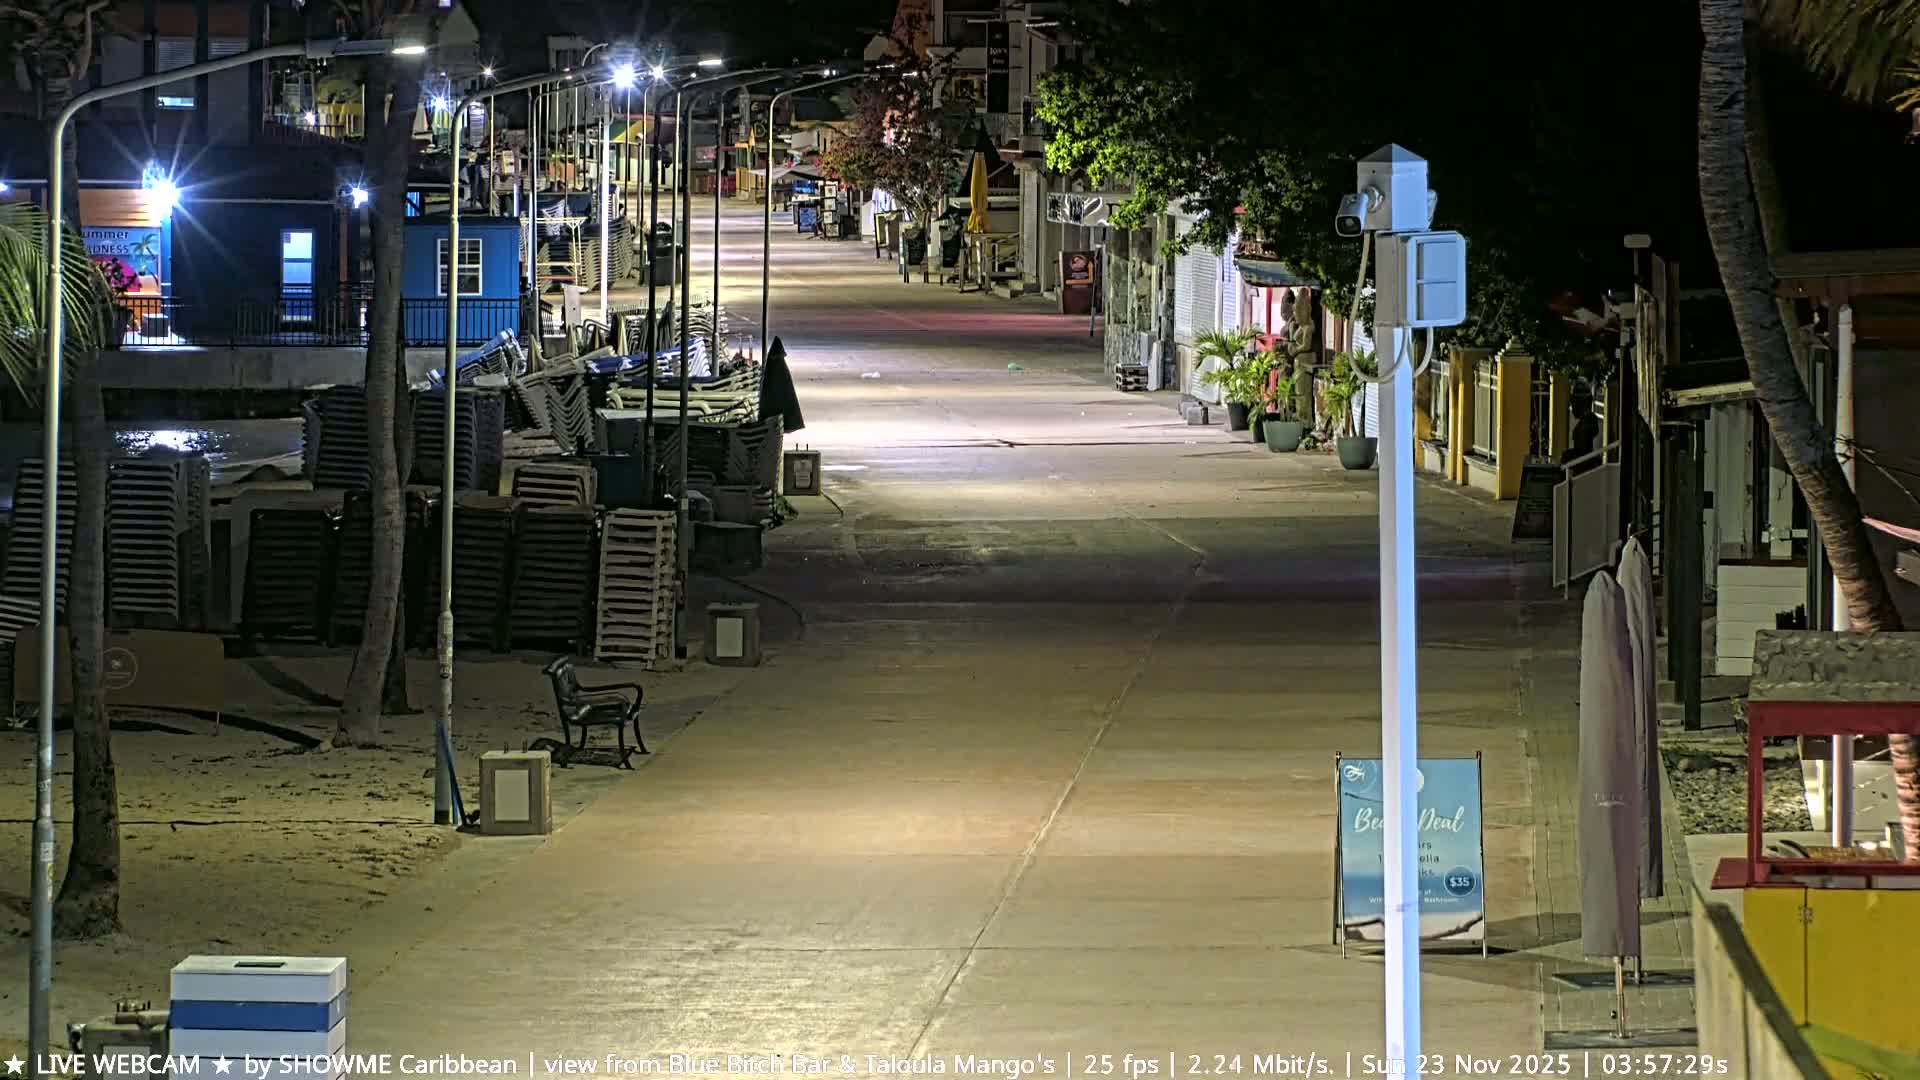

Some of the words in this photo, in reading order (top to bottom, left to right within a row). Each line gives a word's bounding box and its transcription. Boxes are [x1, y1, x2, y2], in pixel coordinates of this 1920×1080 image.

[83, 230, 129, 240] ummer
[88, 244, 129, 254] ADNESS
[1417, 805, 1465, 833] Deal
[1449, 876, 1470, 888] $35
